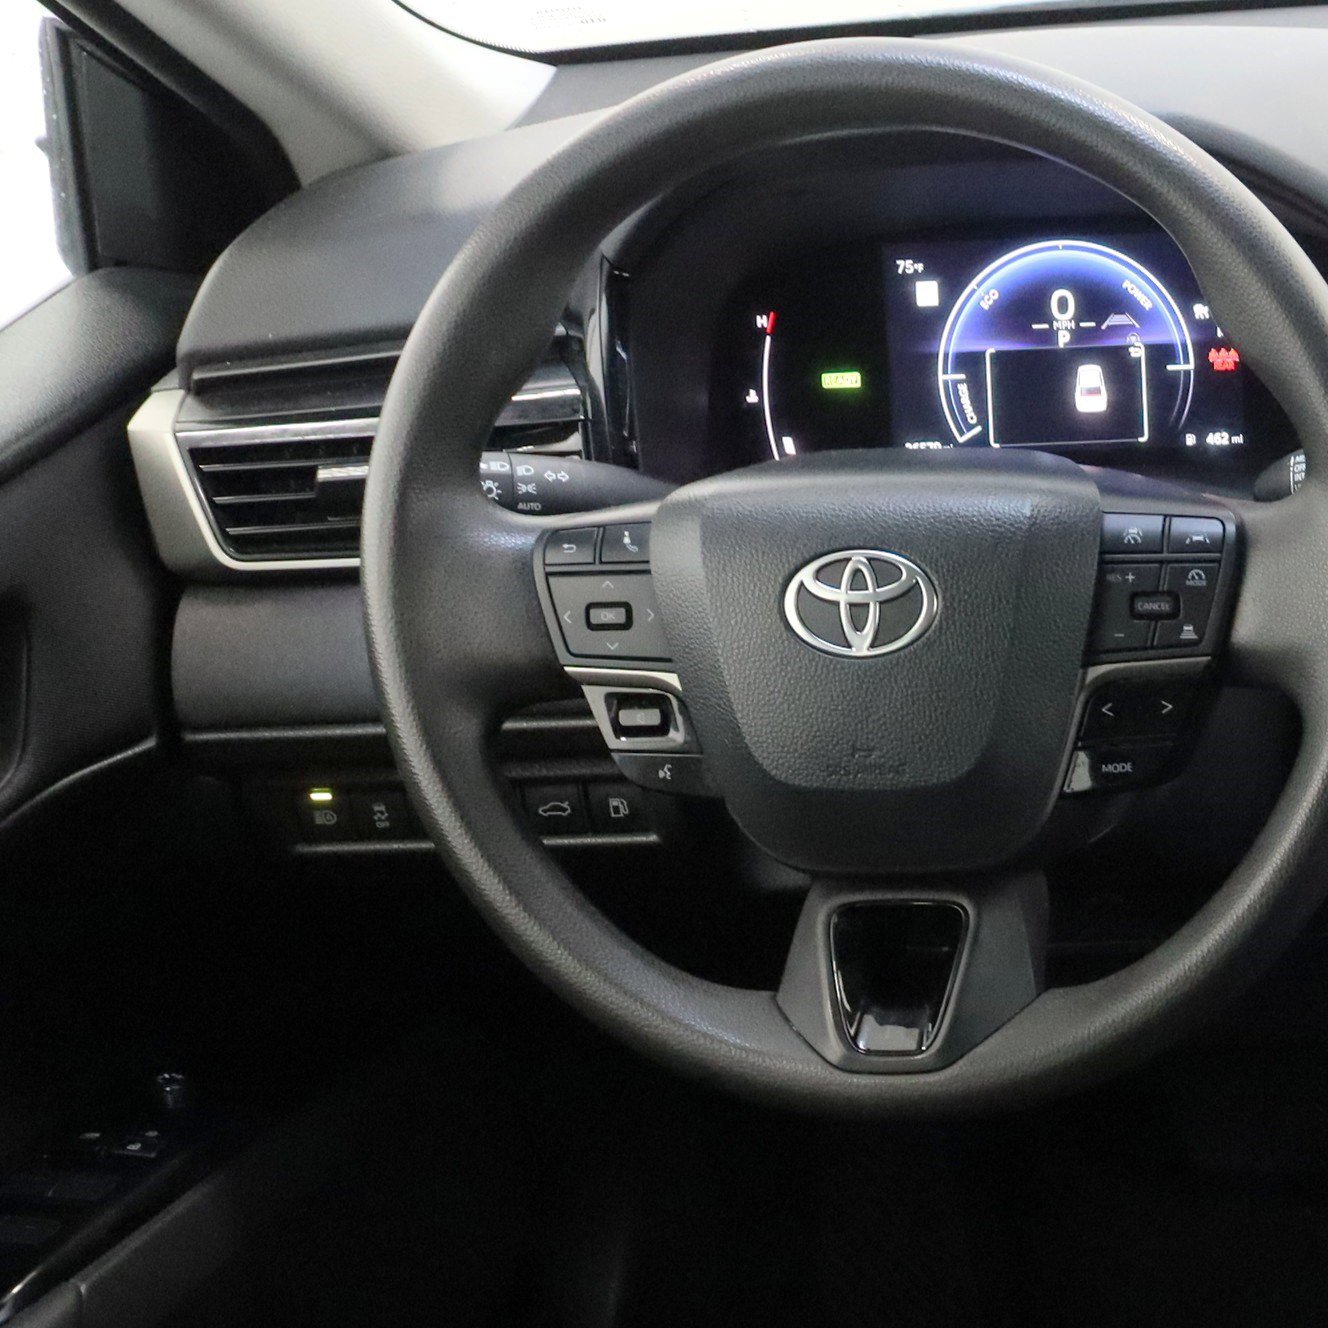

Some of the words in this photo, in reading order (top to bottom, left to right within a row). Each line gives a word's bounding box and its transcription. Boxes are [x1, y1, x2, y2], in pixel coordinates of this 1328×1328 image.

[1121, 280, 1153, 311] POWER
[1053, 320, 1076, 331] MPH
[1057, 330, 1071, 349] P
[823, 374, 859, 387] READY
[957, 382, 978, 425] CHARGE
[1205, 431, 1230, 446] 462
[517, 502, 542, 511] AUTO
[1136, 602, 1171, 611] CANCEL
[1101, 762, 1134, 774] MODE
